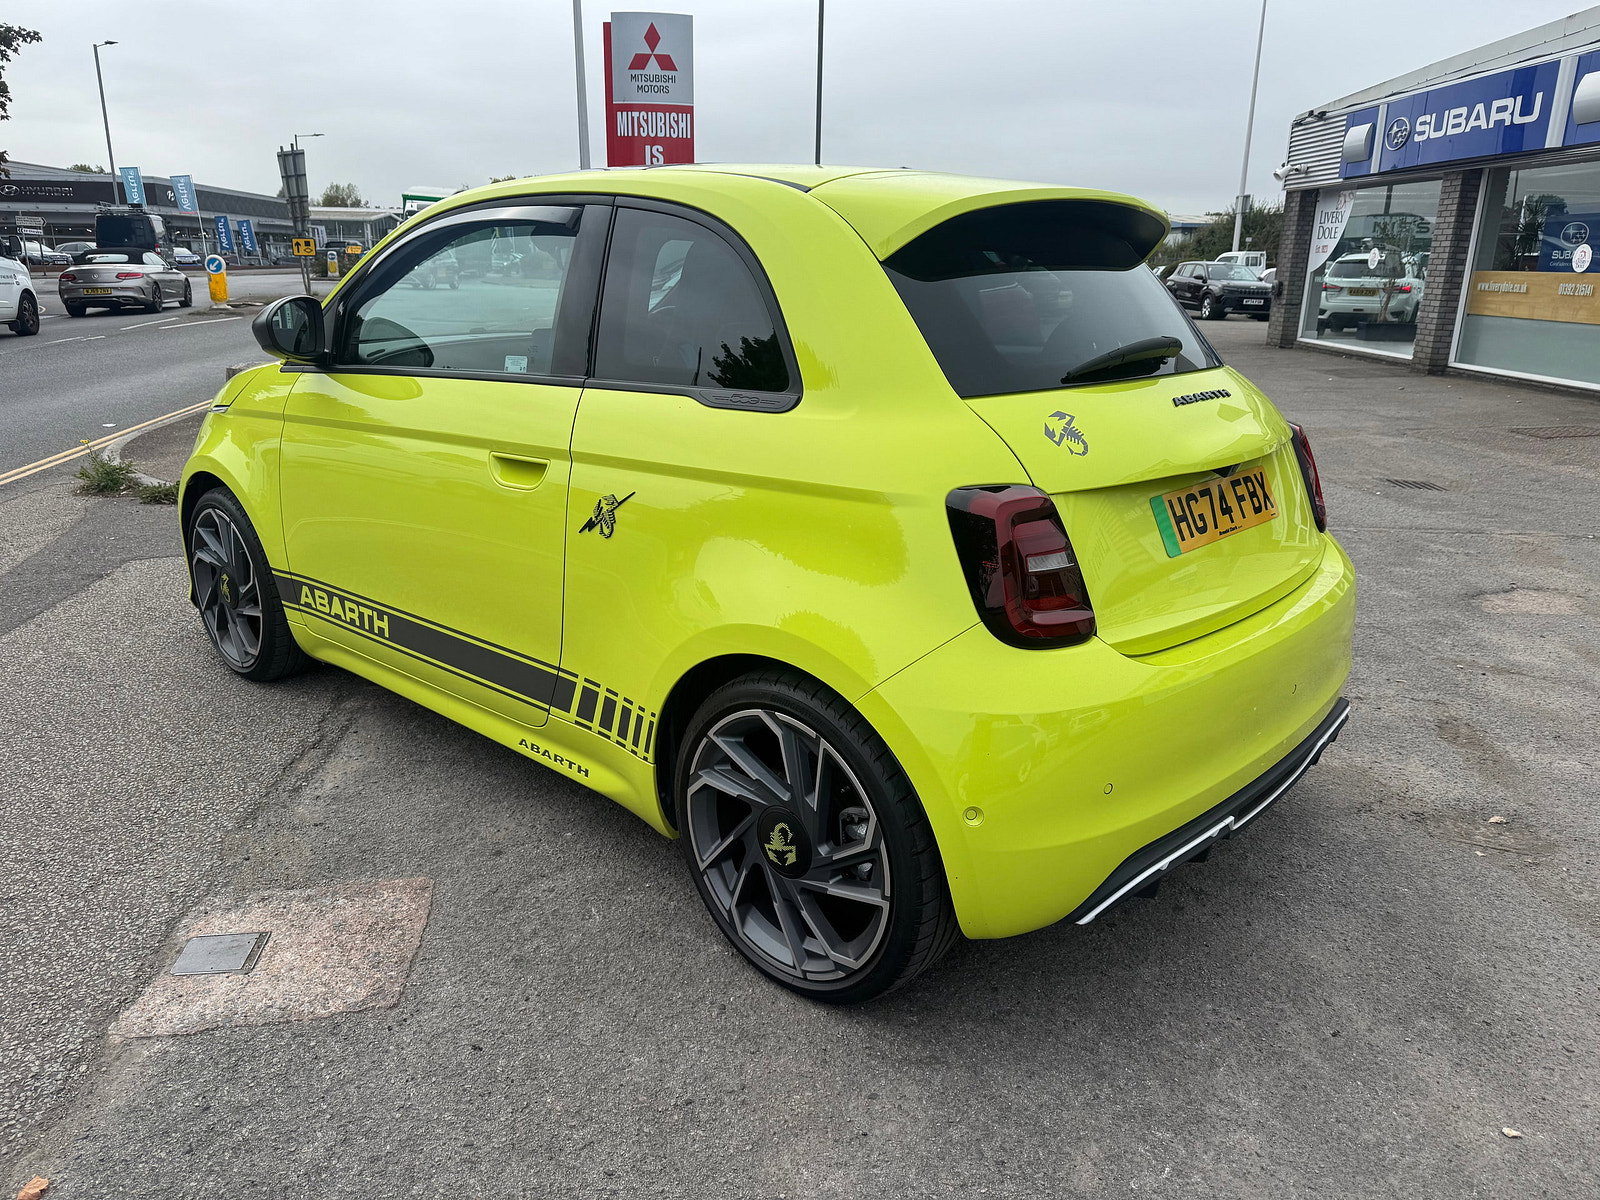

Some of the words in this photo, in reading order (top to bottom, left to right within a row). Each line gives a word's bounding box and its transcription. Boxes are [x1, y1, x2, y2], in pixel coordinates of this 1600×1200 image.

[630, 73, 676, 84] MITSUBISHI
[636, 84, 670, 94] MOTORS
[616, 111, 691, 139] MITSUBISHI
[1413, 91, 1544, 142] SUBARU
[644, 145, 665, 165] IS
[1319, 210, 1346, 224] LIVERY
[1317, 225, 1339, 239] DOLE
[1551, 250, 1574, 260] SUB
[730, 393, 760, 405] 500
[1172, 389, 1232, 408] ABARTH
[1167, 483, 1234, 542] HG74
[1230, 471, 1275, 520] FBX
[299, 585, 391, 638] ABARTH
[518, 738, 590, 778] ABARTH
